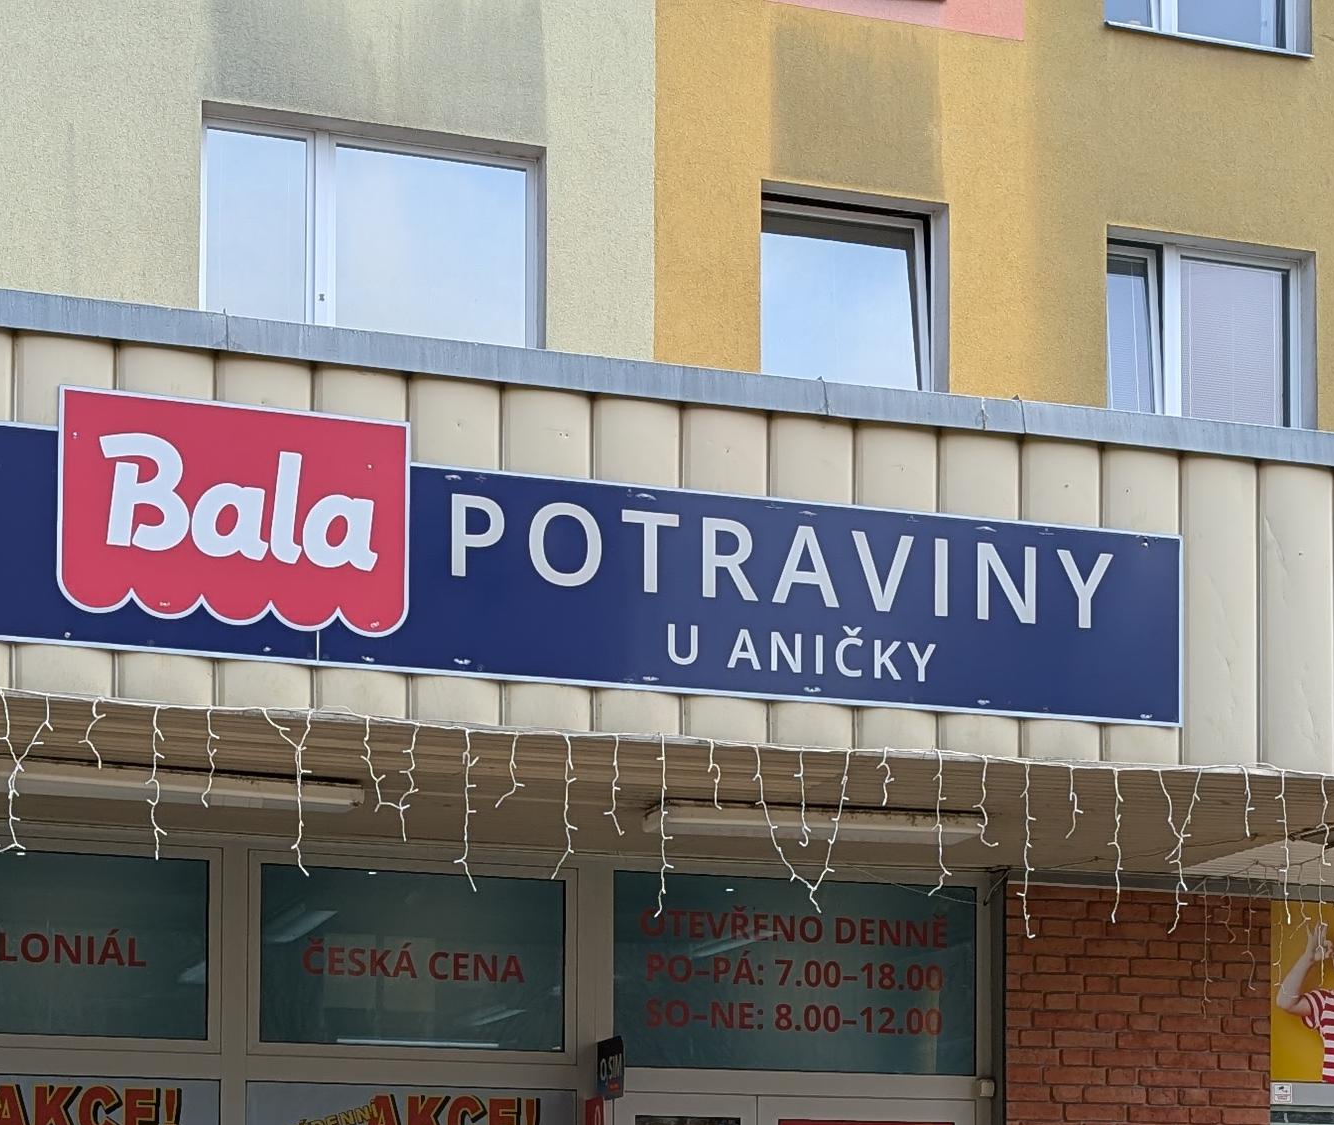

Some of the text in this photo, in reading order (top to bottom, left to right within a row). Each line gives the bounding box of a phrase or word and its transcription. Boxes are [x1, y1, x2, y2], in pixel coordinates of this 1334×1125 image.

[99, 432, 378, 572] Bala
[450, 494, 1114, 629] POTRAVINY
[666, 622, 937, 683] U ANIČKY
[639, 905, 949, 949] OTEVŘENO DENNĚ
[302, 937, 525, 983] ČESKÁ CENA
